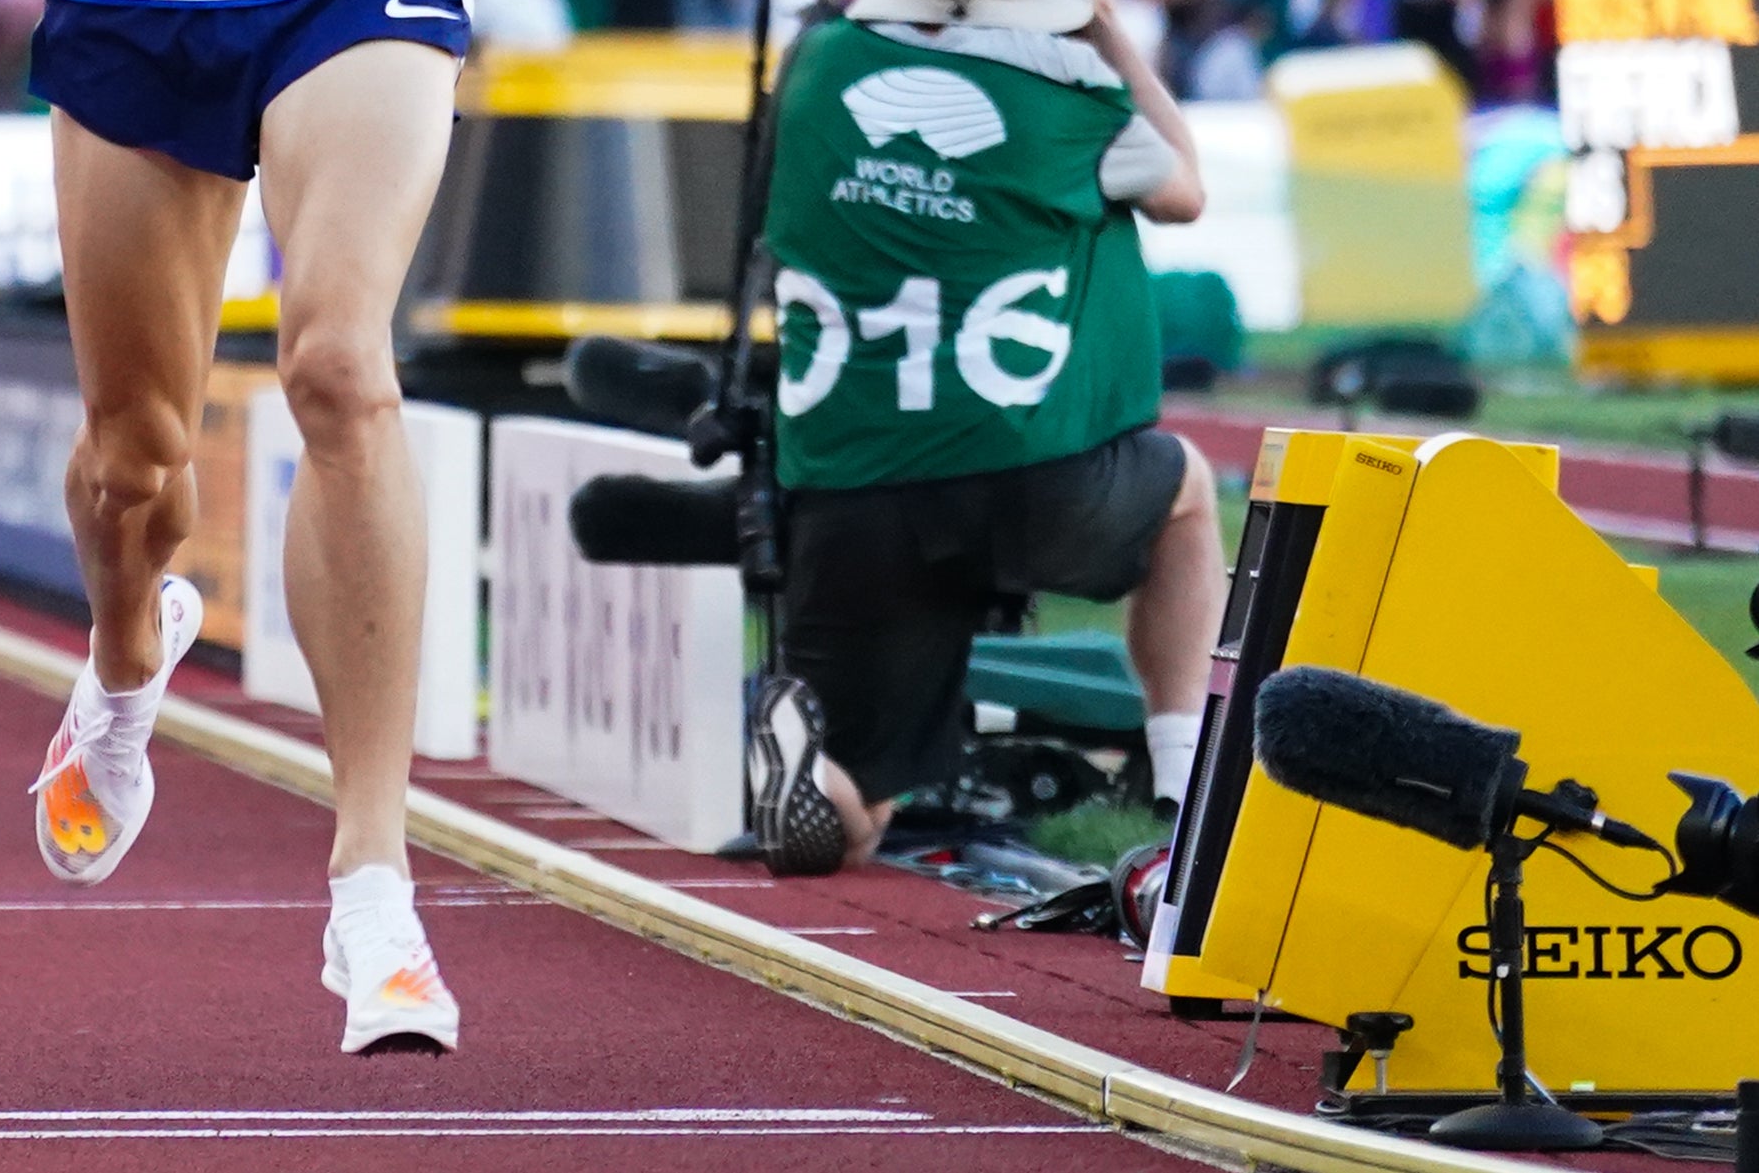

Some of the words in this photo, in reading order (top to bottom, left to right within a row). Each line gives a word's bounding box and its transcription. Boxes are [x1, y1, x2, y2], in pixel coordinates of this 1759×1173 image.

[855, 157, 955, 193] WORLD
[829, 178, 977, 223] ATHLETICS
[1355, 452, 1404, 476] SEIKO
[1456, 924, 1743, 980] SEIKO
